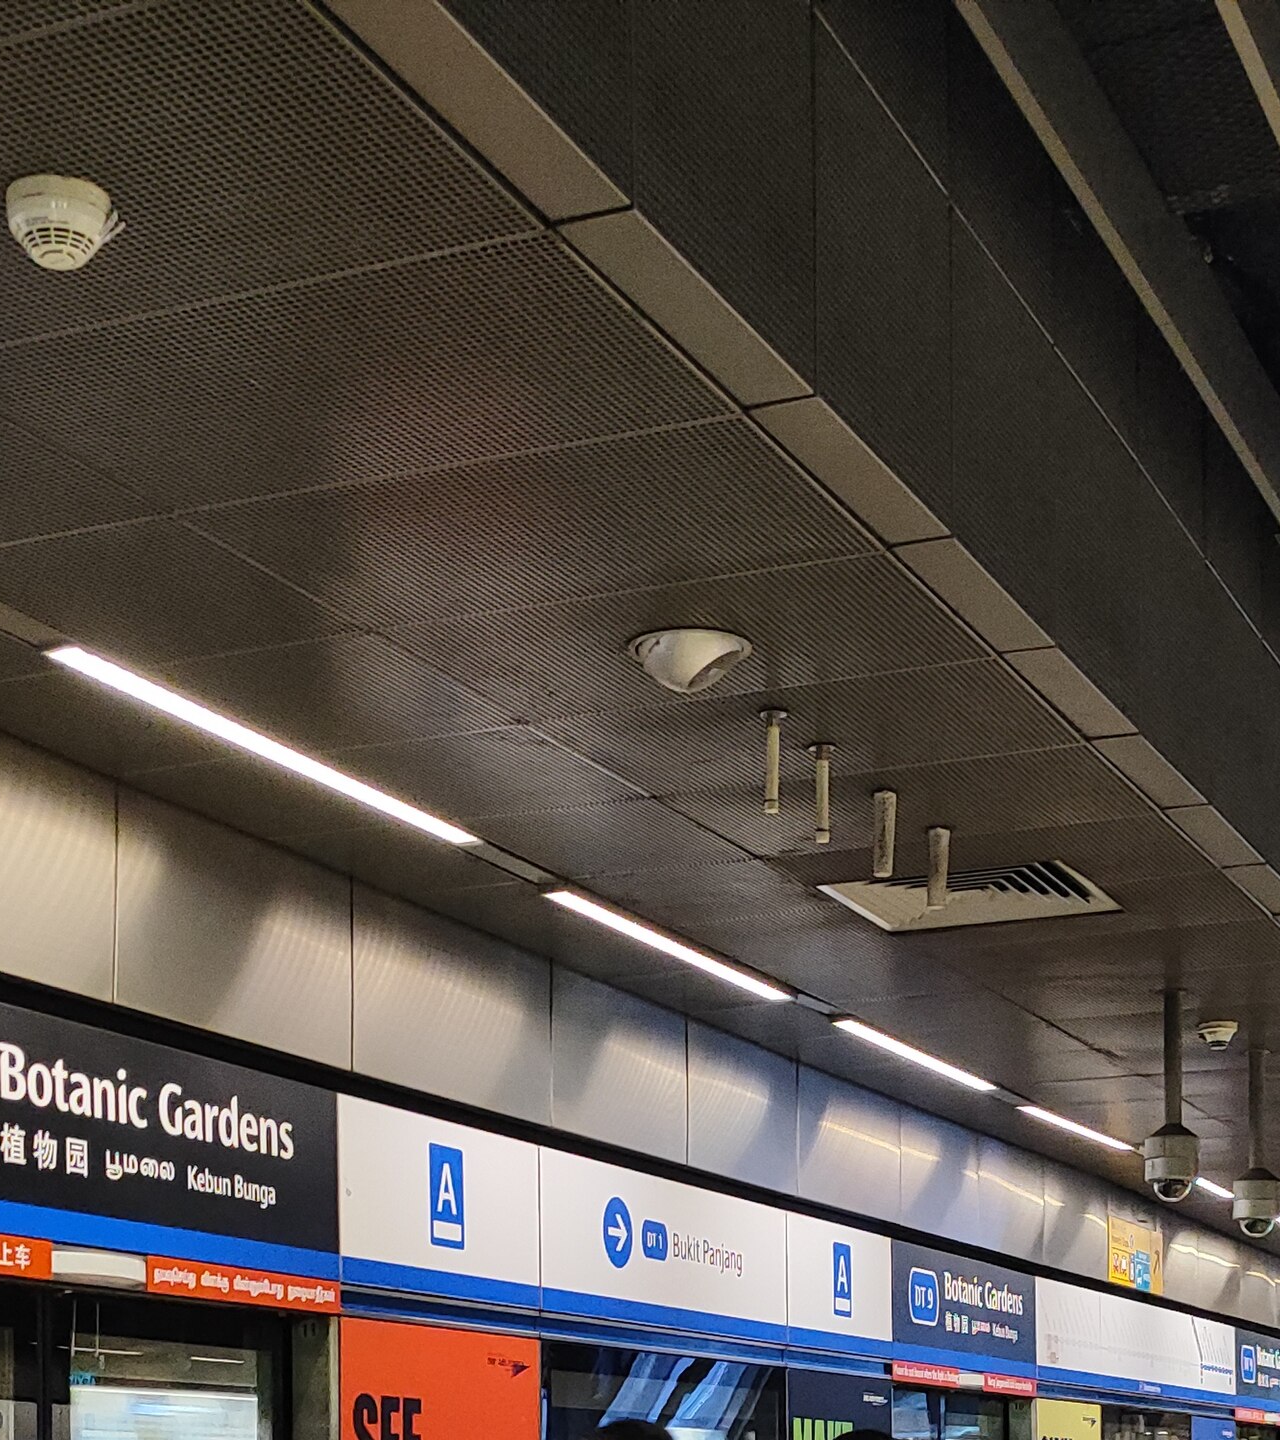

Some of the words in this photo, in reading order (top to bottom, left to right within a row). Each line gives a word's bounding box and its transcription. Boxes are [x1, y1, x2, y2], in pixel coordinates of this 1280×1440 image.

[158, 1081, 295, 1161] Gardens
[0, 1122, 90, 1178] 植物园
[187, 1164, 232, 1199] Kebun
[233, 1173, 278, 1210] Bunga
[436, 1162, 459, 1219] A
[646, 1230, 656, 1248] DT
[657, 1234, 664, 1250] 1
[672, 1232, 701, 1264] Bukit
[702, 1242, 744, 1277] Panjang
[836, 1254, 849, 1294] A
[914, 1284, 927, 1309] DT
[927, 1289, 934, 1310] 9
[943, 1271, 984, 1309] Botanic
[984, 1281, 1024, 1316] Gardens
